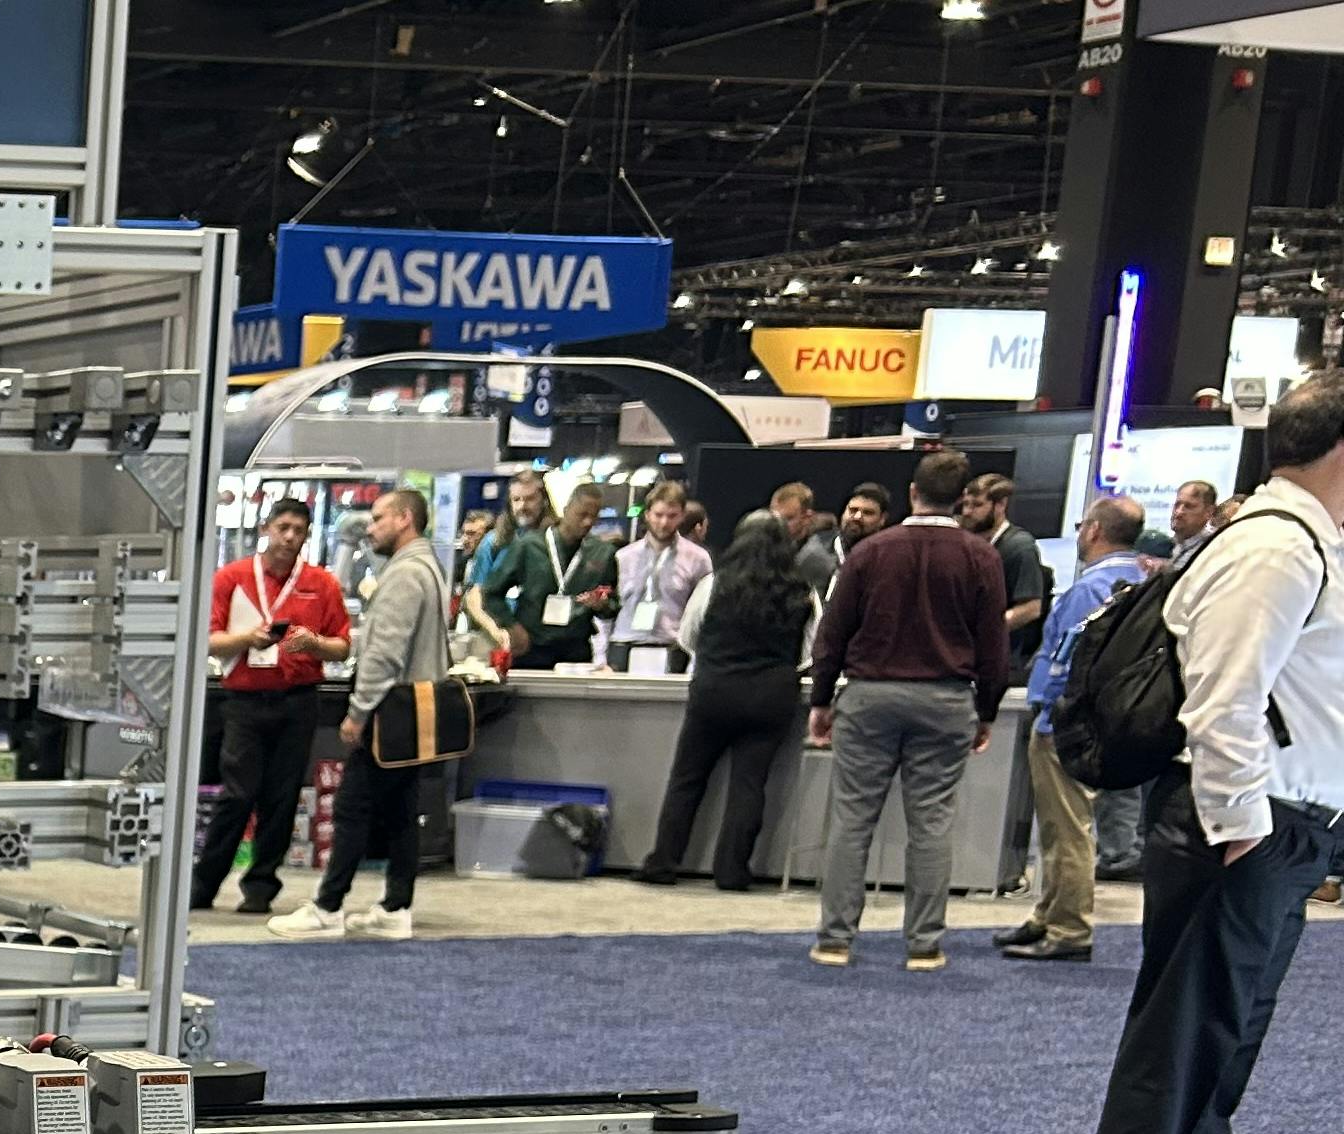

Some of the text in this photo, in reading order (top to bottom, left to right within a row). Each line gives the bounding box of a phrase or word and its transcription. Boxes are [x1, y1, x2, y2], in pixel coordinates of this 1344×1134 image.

[1078, 43, 1122, 69] AB20
[324, 244, 611, 312] YASKAWA
[795, 347, 906, 374] FANUC
